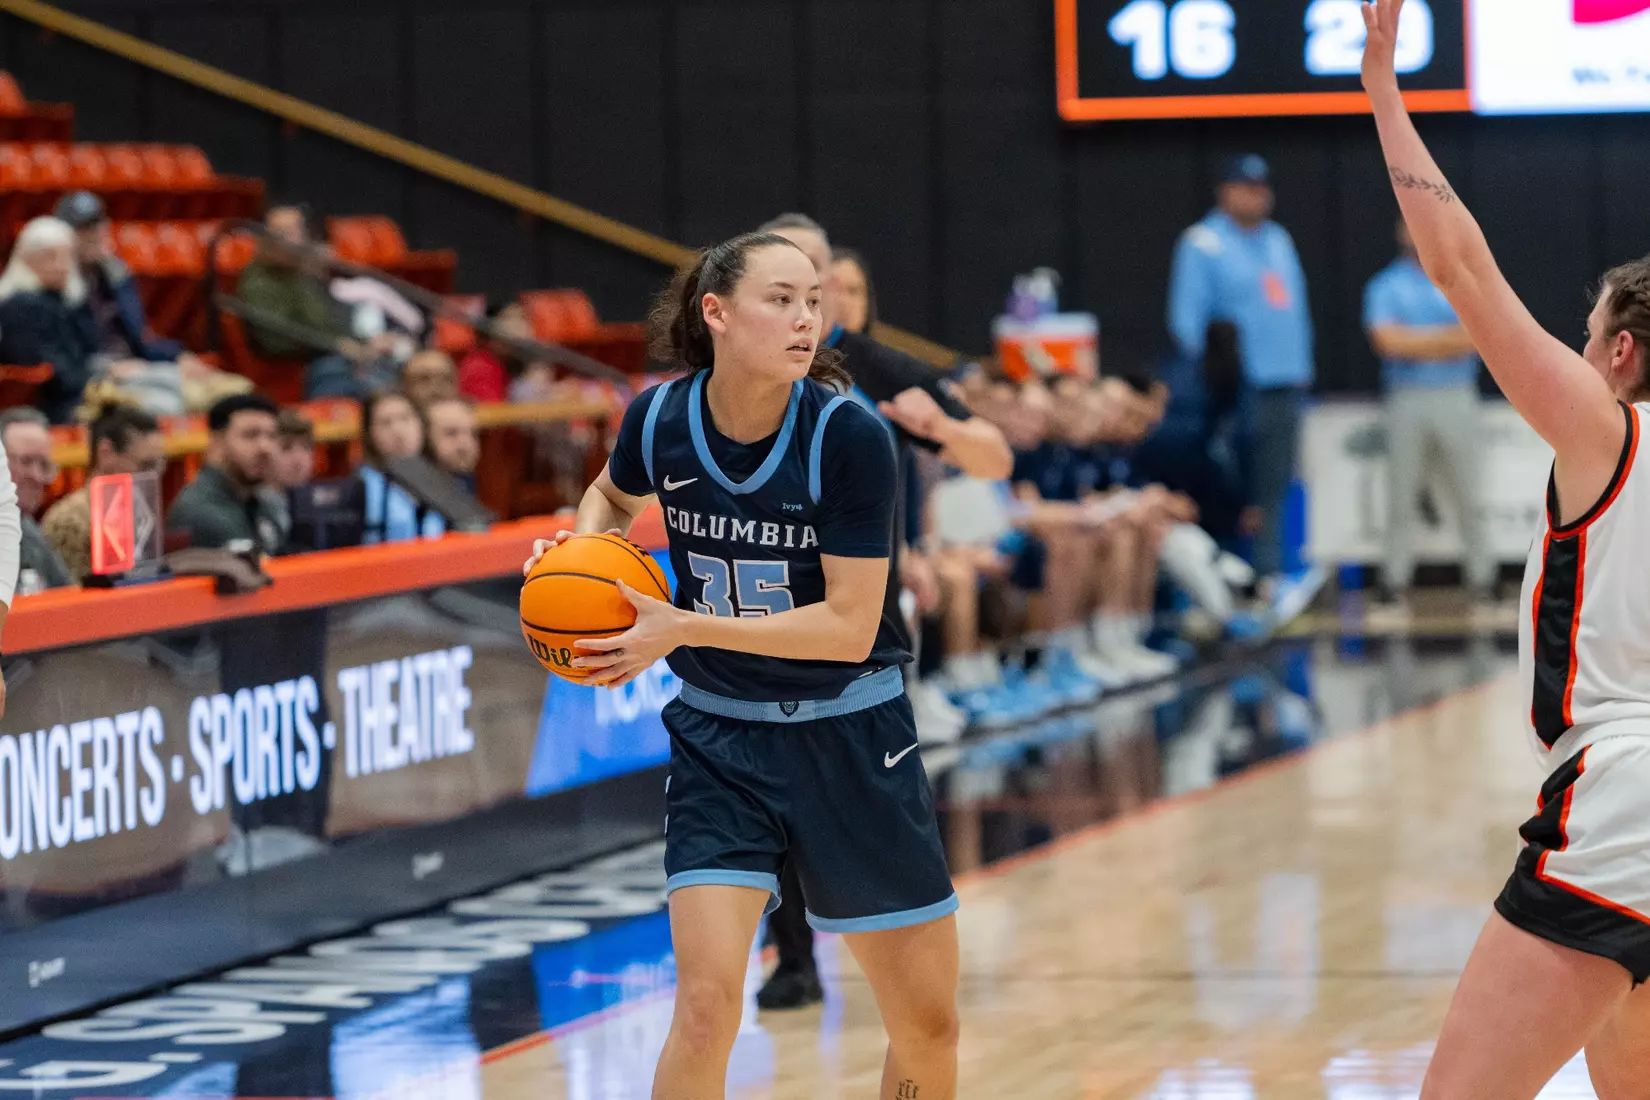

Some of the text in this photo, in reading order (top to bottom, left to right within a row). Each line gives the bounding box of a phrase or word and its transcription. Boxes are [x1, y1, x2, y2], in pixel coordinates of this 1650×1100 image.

[1107, 0, 1237, 80] 16
[667, 505, 819, 549] COLUMBIA
[688, 551, 795, 618] 35
[528, 634, 583, 668] Wil
[189, 674, 322, 815] SPORTS
[338, 645, 475, 779] THEATRE
